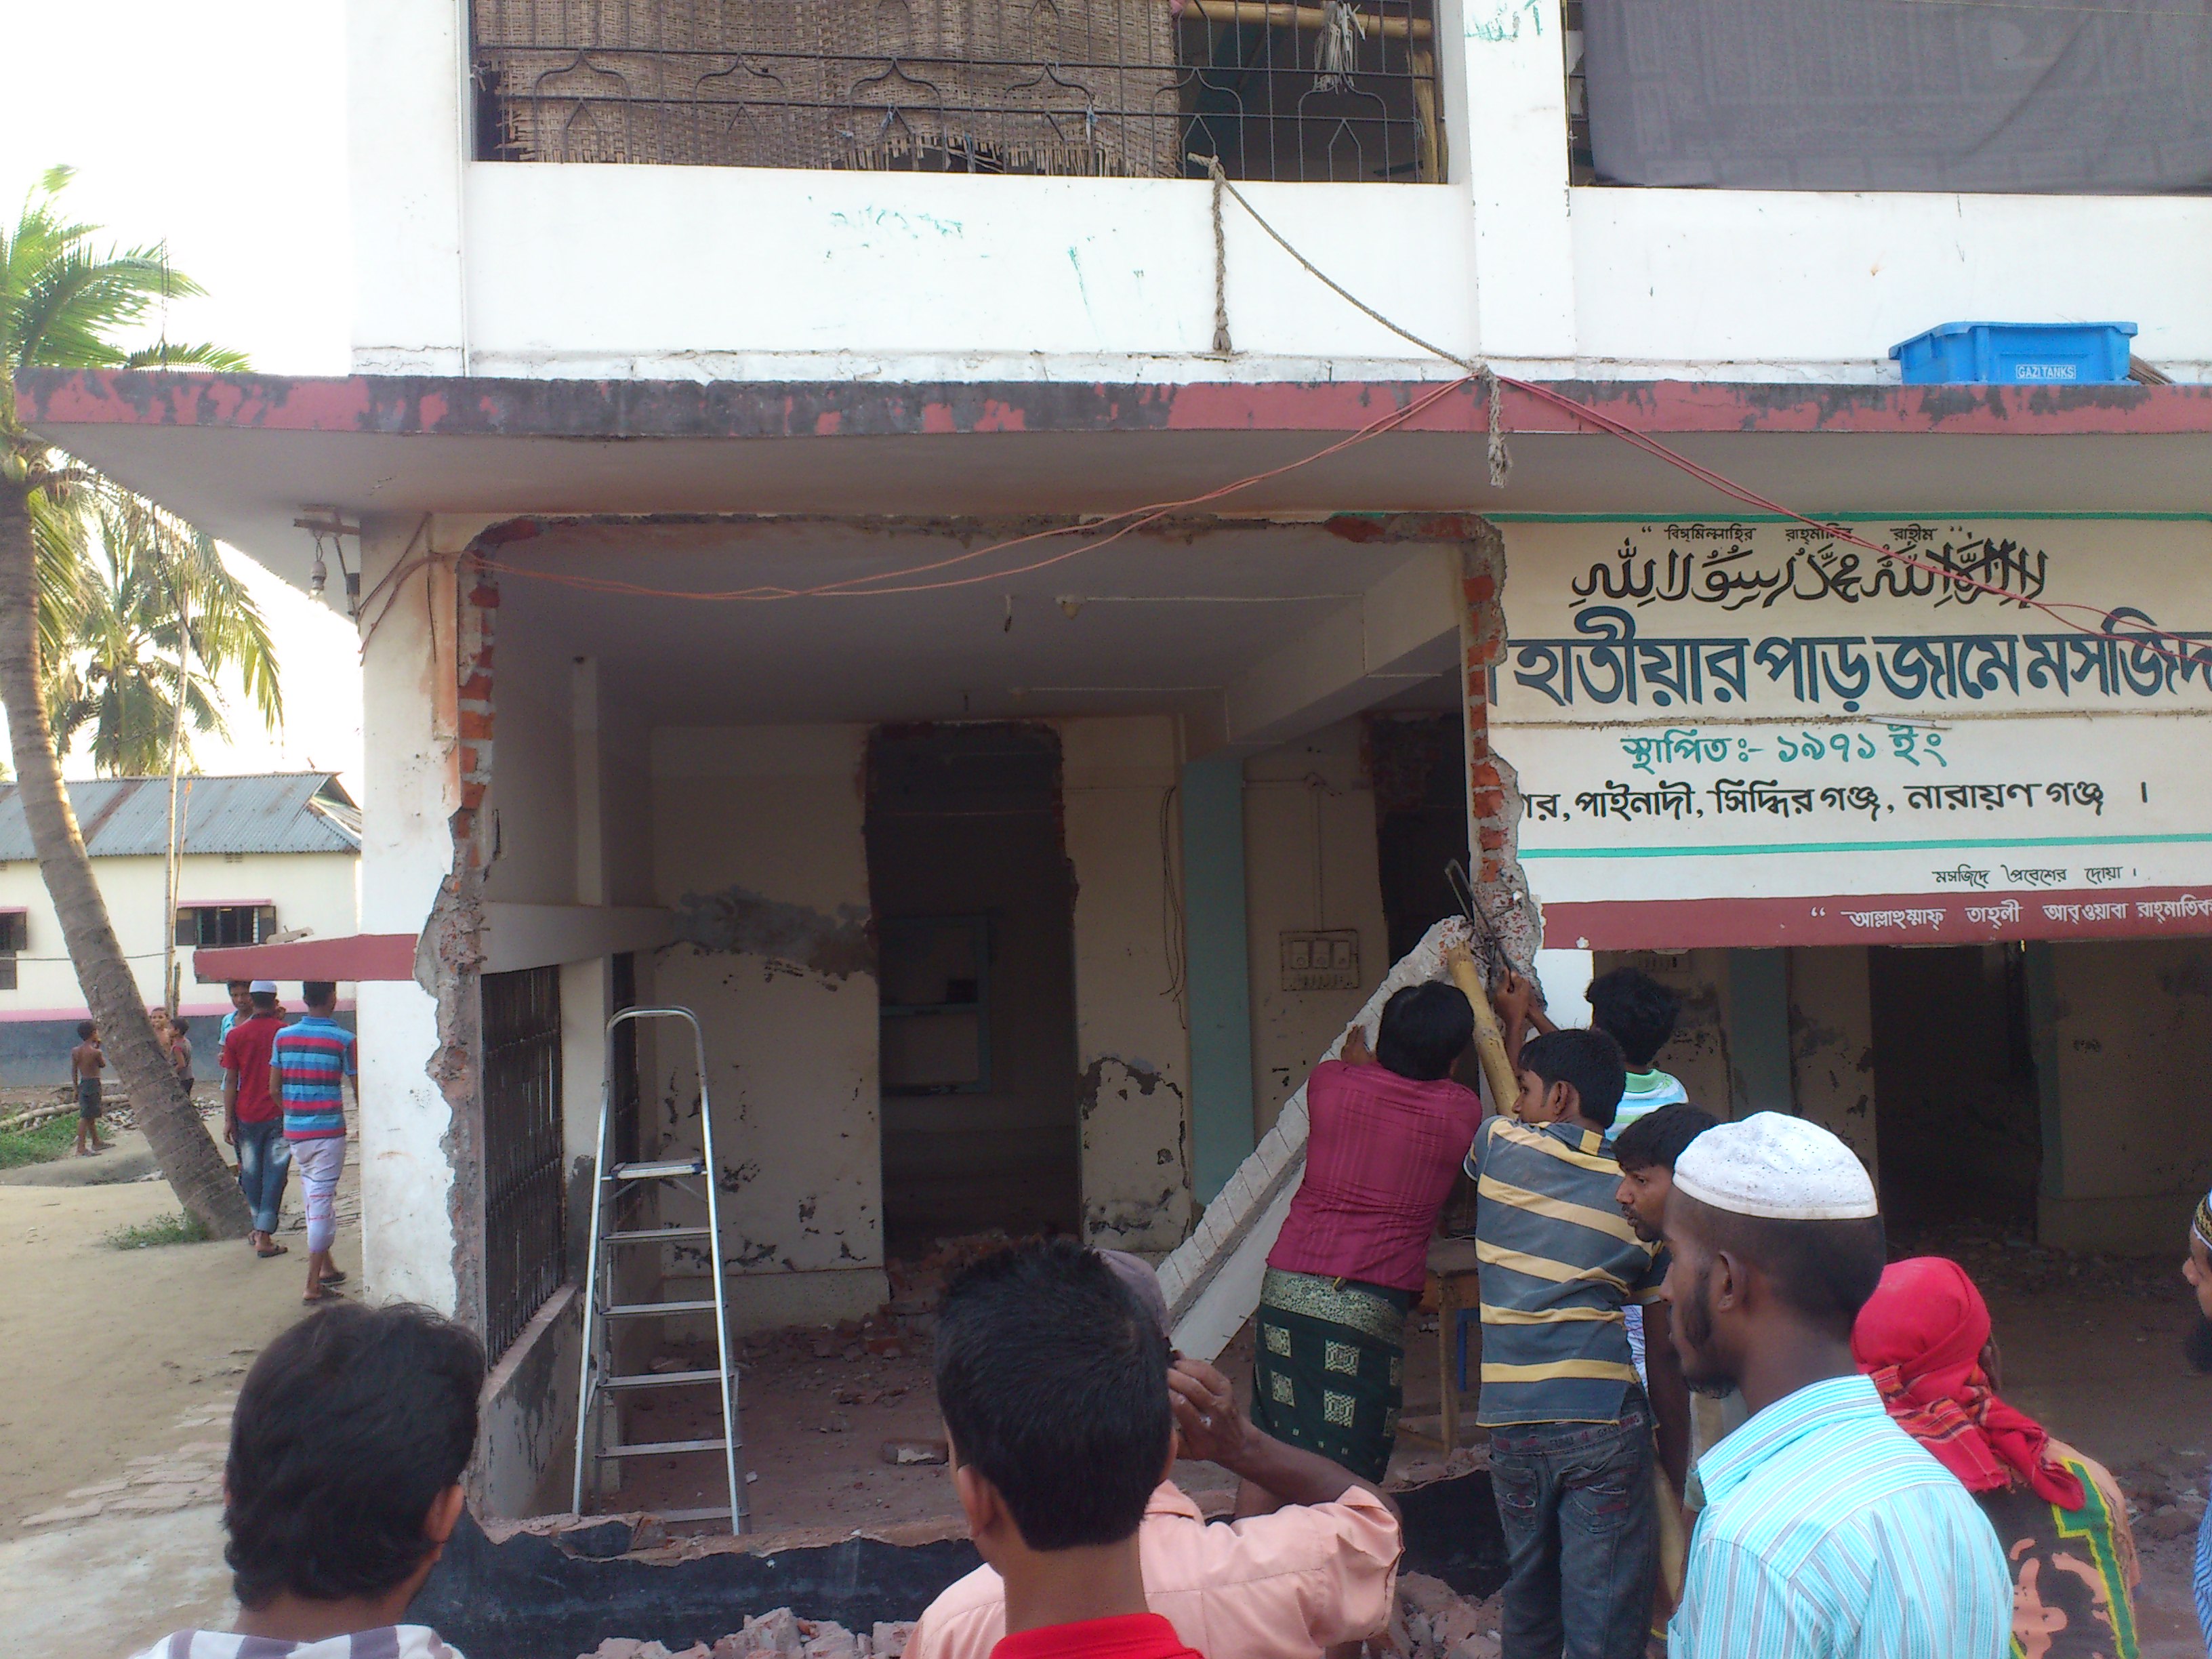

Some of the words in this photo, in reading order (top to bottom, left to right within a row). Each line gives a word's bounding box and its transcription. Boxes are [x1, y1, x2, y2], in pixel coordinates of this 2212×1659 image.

[2018, 366, 2041, 378] GAZI
[2041, 366, 2074, 378] TANKS
[1777, 730, 1876, 764] ১৯৭১
